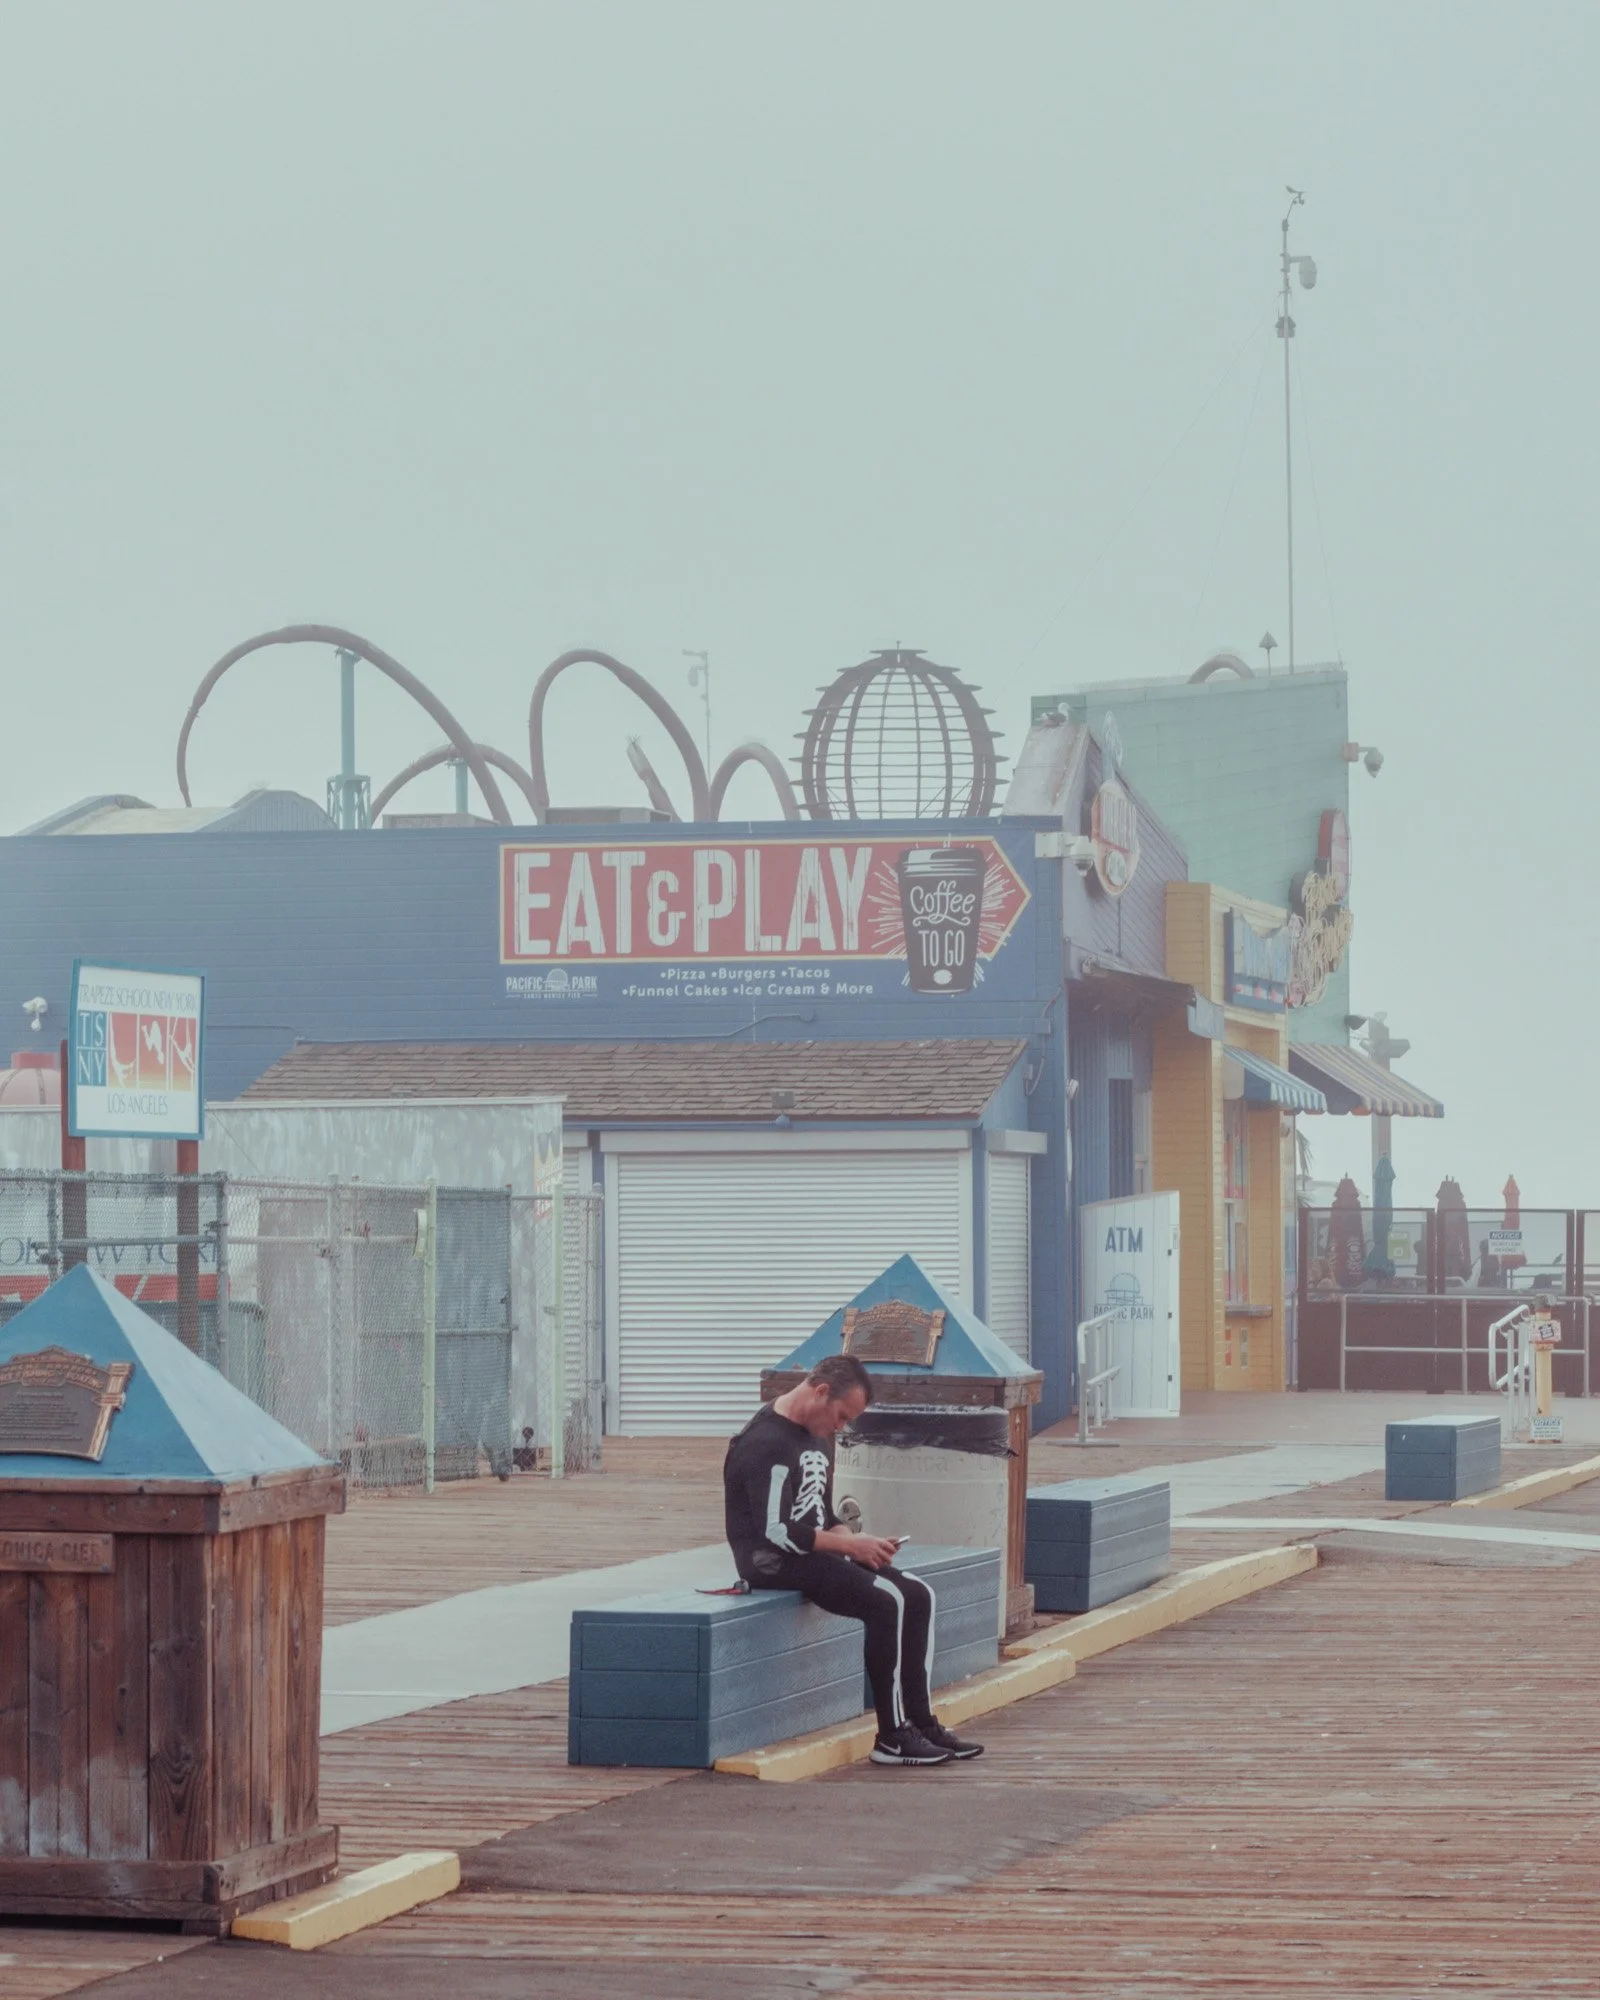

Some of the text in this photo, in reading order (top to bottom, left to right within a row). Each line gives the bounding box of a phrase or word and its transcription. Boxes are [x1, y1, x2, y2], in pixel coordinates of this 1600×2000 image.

[514, 847, 872, 955] EAT & PLAY
[910, 880, 975, 926] Coffee
[918, 930, 964, 966] TO GO
[506, 976, 597, 990] PACIFIC PARK
[684, 984, 728, 996] Cakes
[767, 983, 815, 995] Cream
[820, 983, 830, 995] &
[836, 982, 874, 995] More
[115, 986, 151, 1009] SCHOOL
[154, 990, 173, 1010] NEW
[176, 992, 197, 1012] YORK
[107, 1093, 168, 1116] LOS ANGELES
[1105, 1227, 1143, 1252] ATM
[1130, 1307, 1154, 1320] PARK
